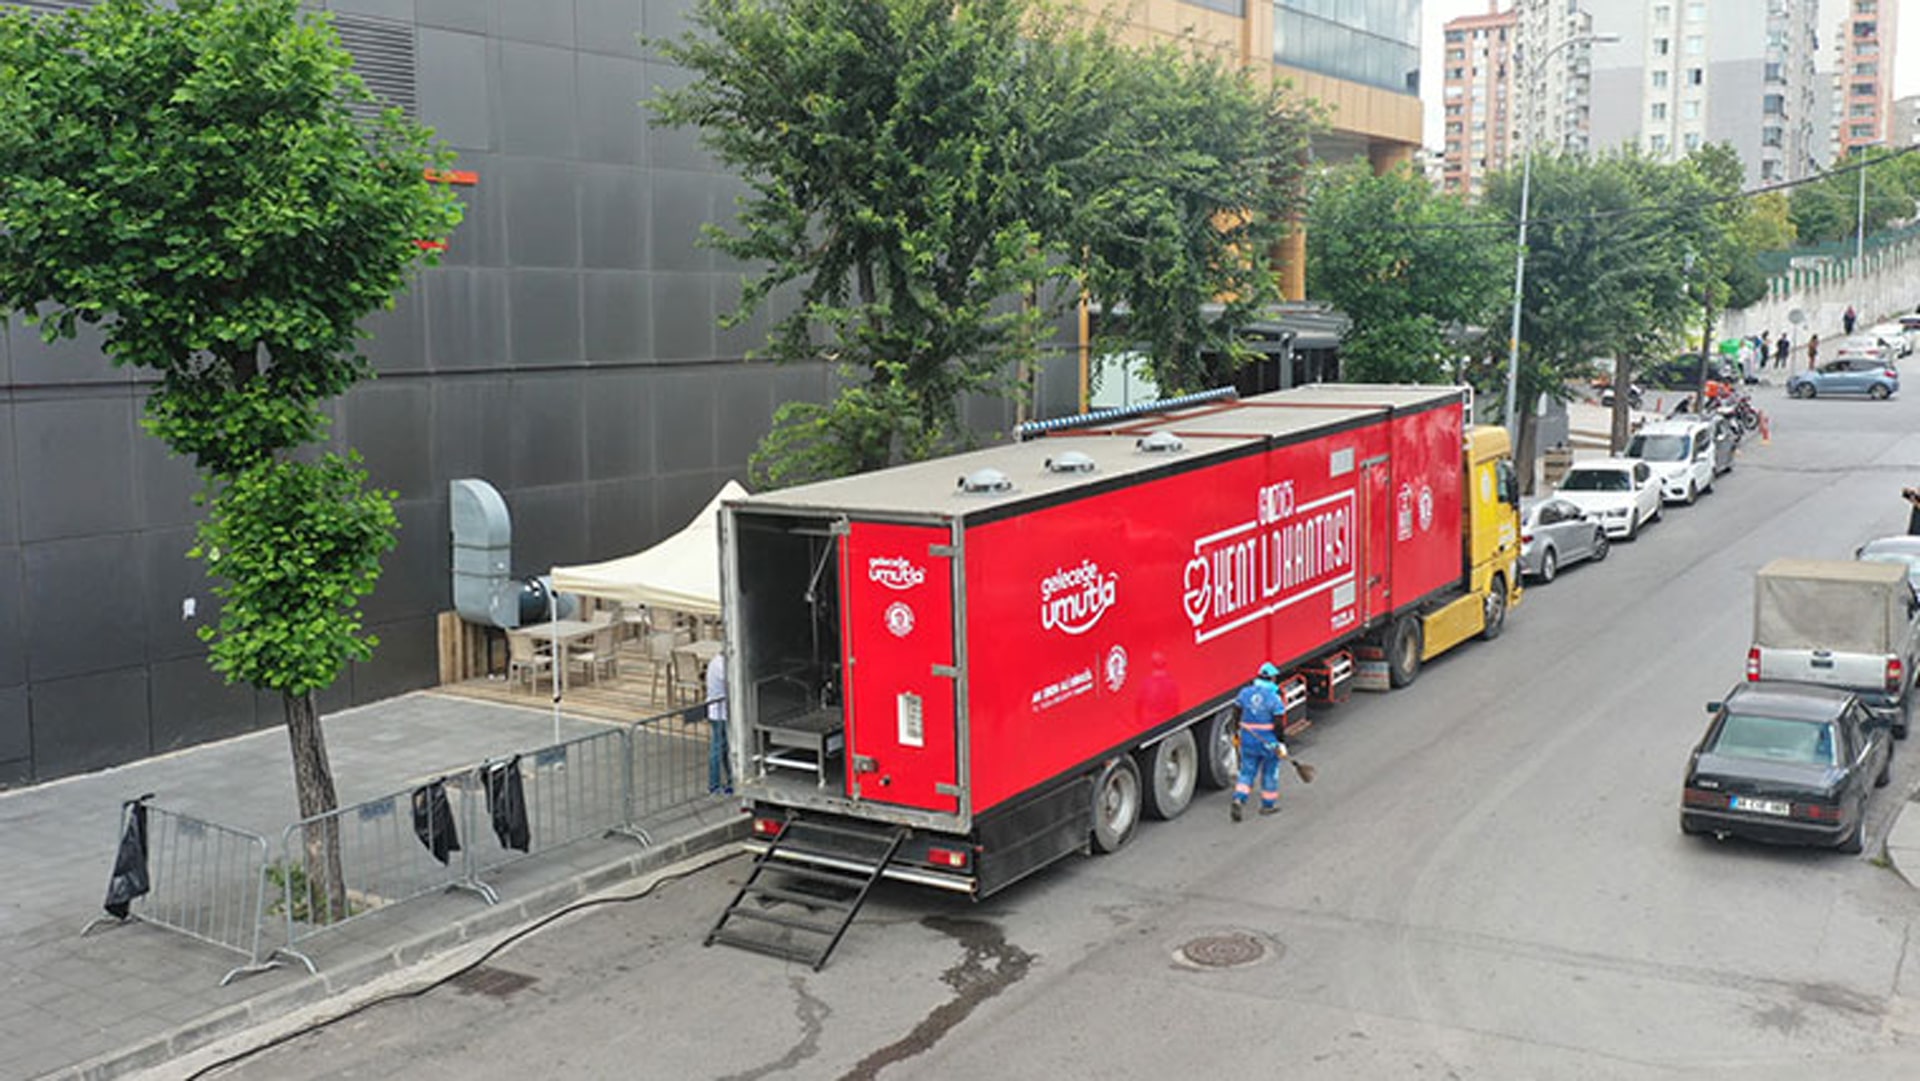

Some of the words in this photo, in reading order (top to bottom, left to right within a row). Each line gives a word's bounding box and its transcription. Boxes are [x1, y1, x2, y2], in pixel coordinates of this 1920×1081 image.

[1041, 559, 1097, 601] geleceğe
[1214, 538, 1256, 618] KENT
[1262, 505, 1350, 598] LOKANTASI
